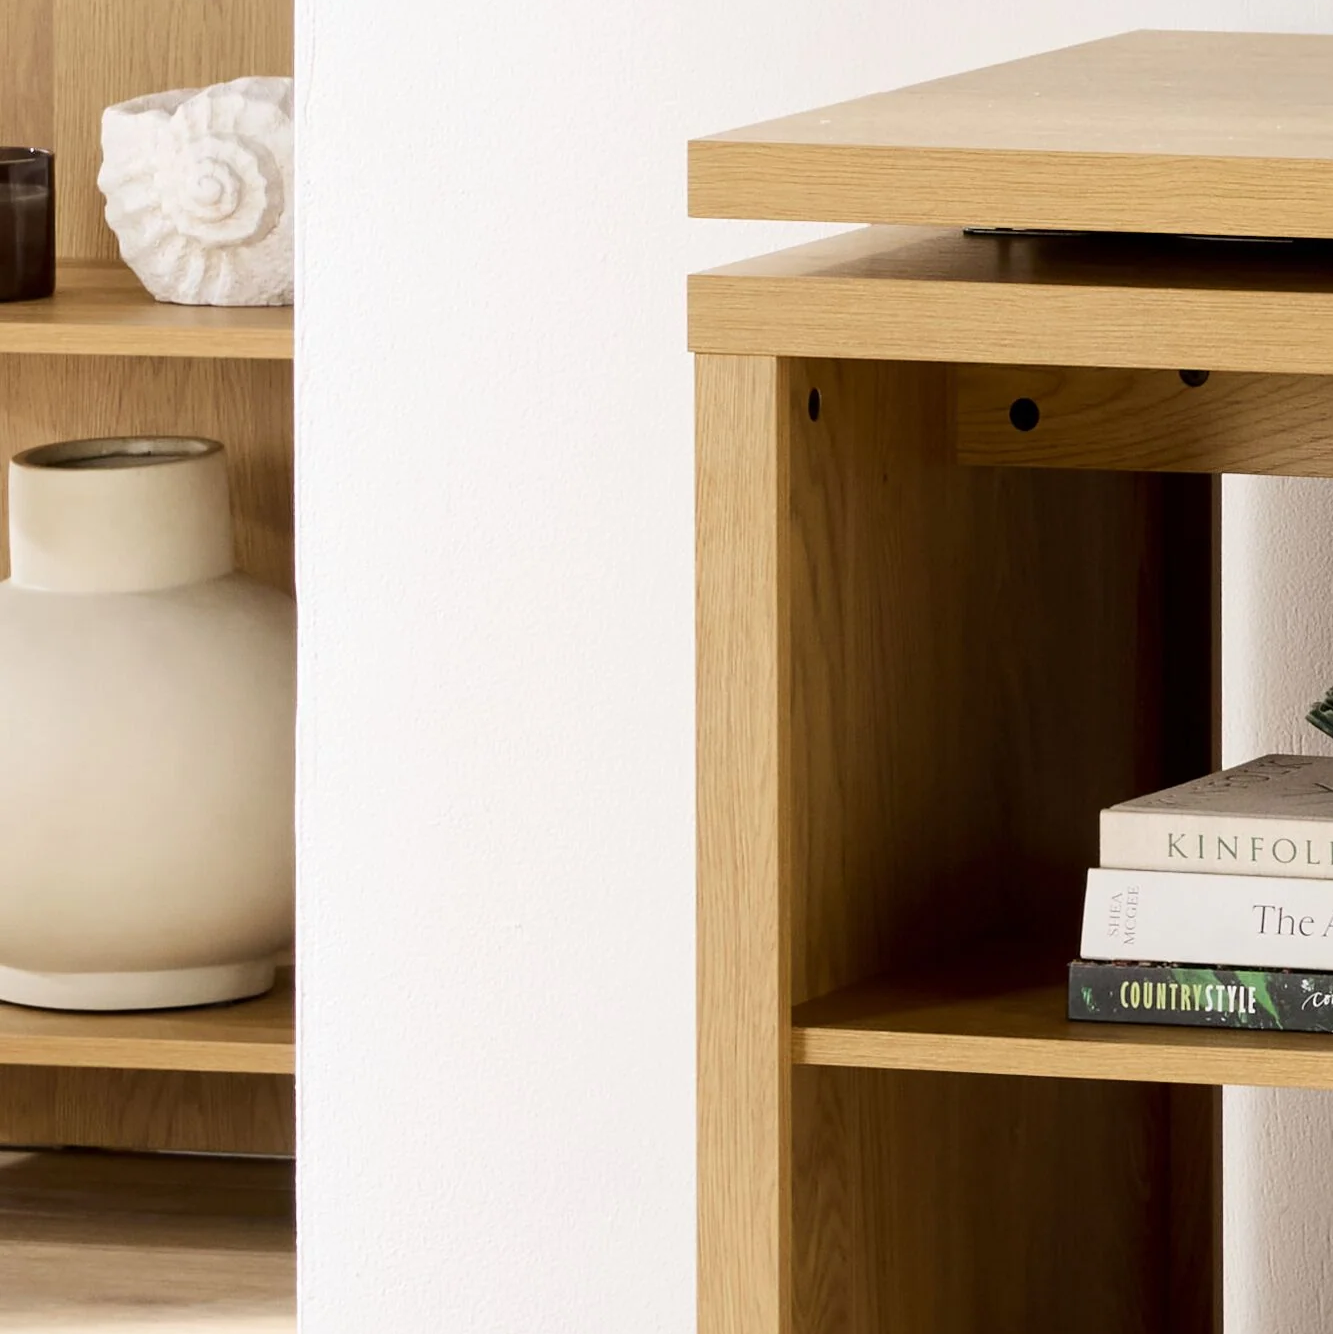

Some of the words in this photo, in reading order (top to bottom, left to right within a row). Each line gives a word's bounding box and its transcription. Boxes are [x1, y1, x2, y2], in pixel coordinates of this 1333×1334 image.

[1109, 892, 1123, 937] SHEA
[1123, 885, 1140, 945] MCGEE
[1252, 904, 1315, 937] The
